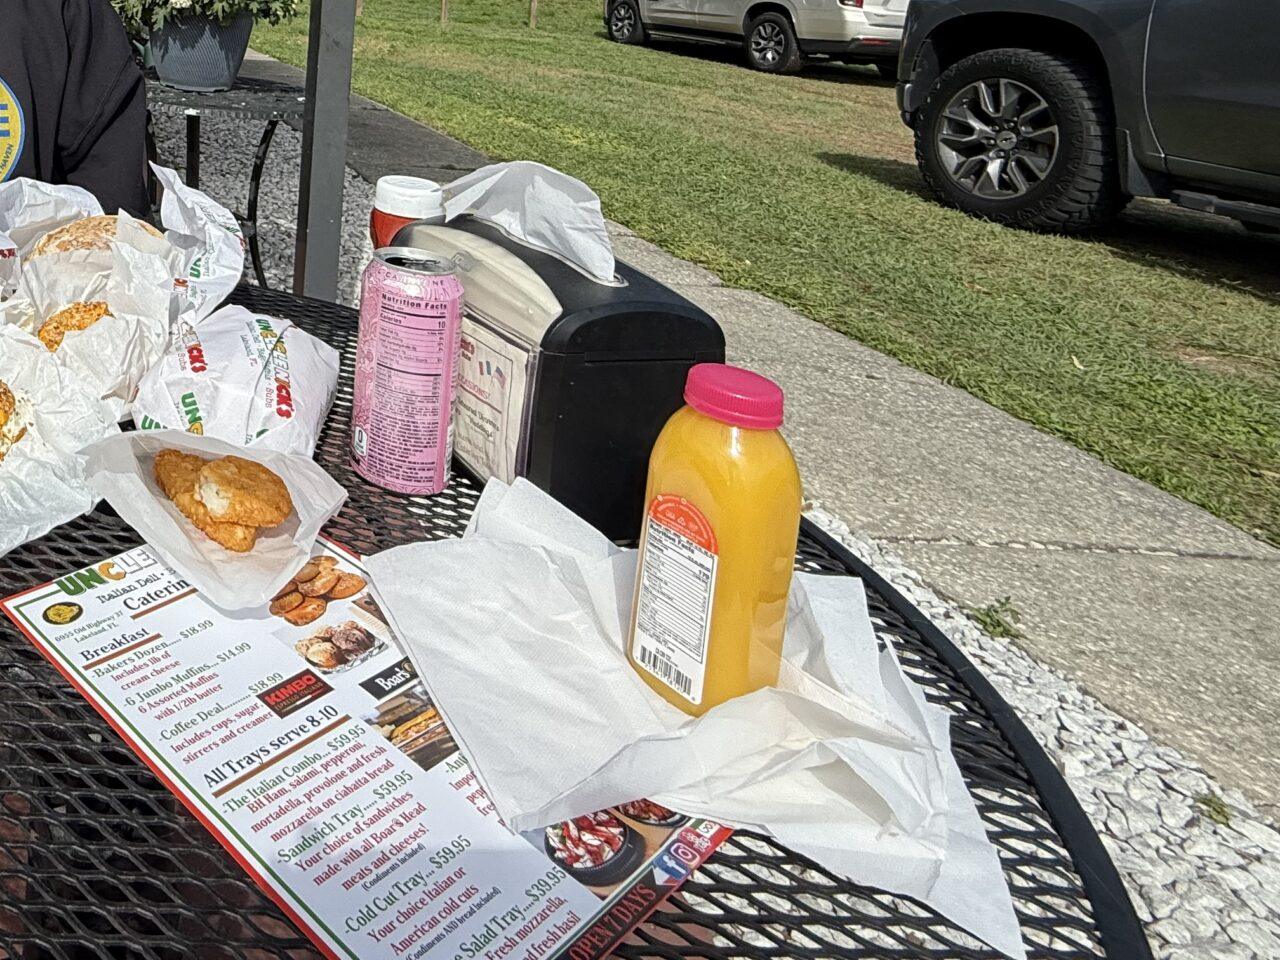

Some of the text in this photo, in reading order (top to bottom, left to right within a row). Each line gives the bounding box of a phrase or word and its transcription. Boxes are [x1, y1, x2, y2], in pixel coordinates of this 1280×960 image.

[382, 293, 421, 308] Nutrition
[54, 548, 158, 596] UNCLE
[96, 572, 160, 604] Italian Deli
[123, 578, 191, 611] Caterin
[80, 628, 150, 661] Breakfast
[180, 620, 214, 639] $18.99
[121, 660, 181, 690] cream cheese
[139, 642, 252, 702] Jumbo $14.99
[265, 674, 316, 705] KIMBO
[148, 672, 219, 710] Assorted Muffins
[203, 705, 339, 788] All Trays serve 8-10
[251, 724, 366, 799] Italian $59.95
[271, 759, 395, 842] mozzarella ciabatta bread
[373, 770, 413, 800] $59.95
[295, 791, 414, 872] Your choice sandwiches
[403, 803, 427, 824] Head
[342, 823, 430, 891] meats cheeses!
[372, 834, 472, 912] Cut $59.95
[525, 866, 567, 902] $39.95
[618, 883, 657, 922] DAYS
[390, 884, 480, 956] American cold cuts
[459, 924, 498, 958] Salad
